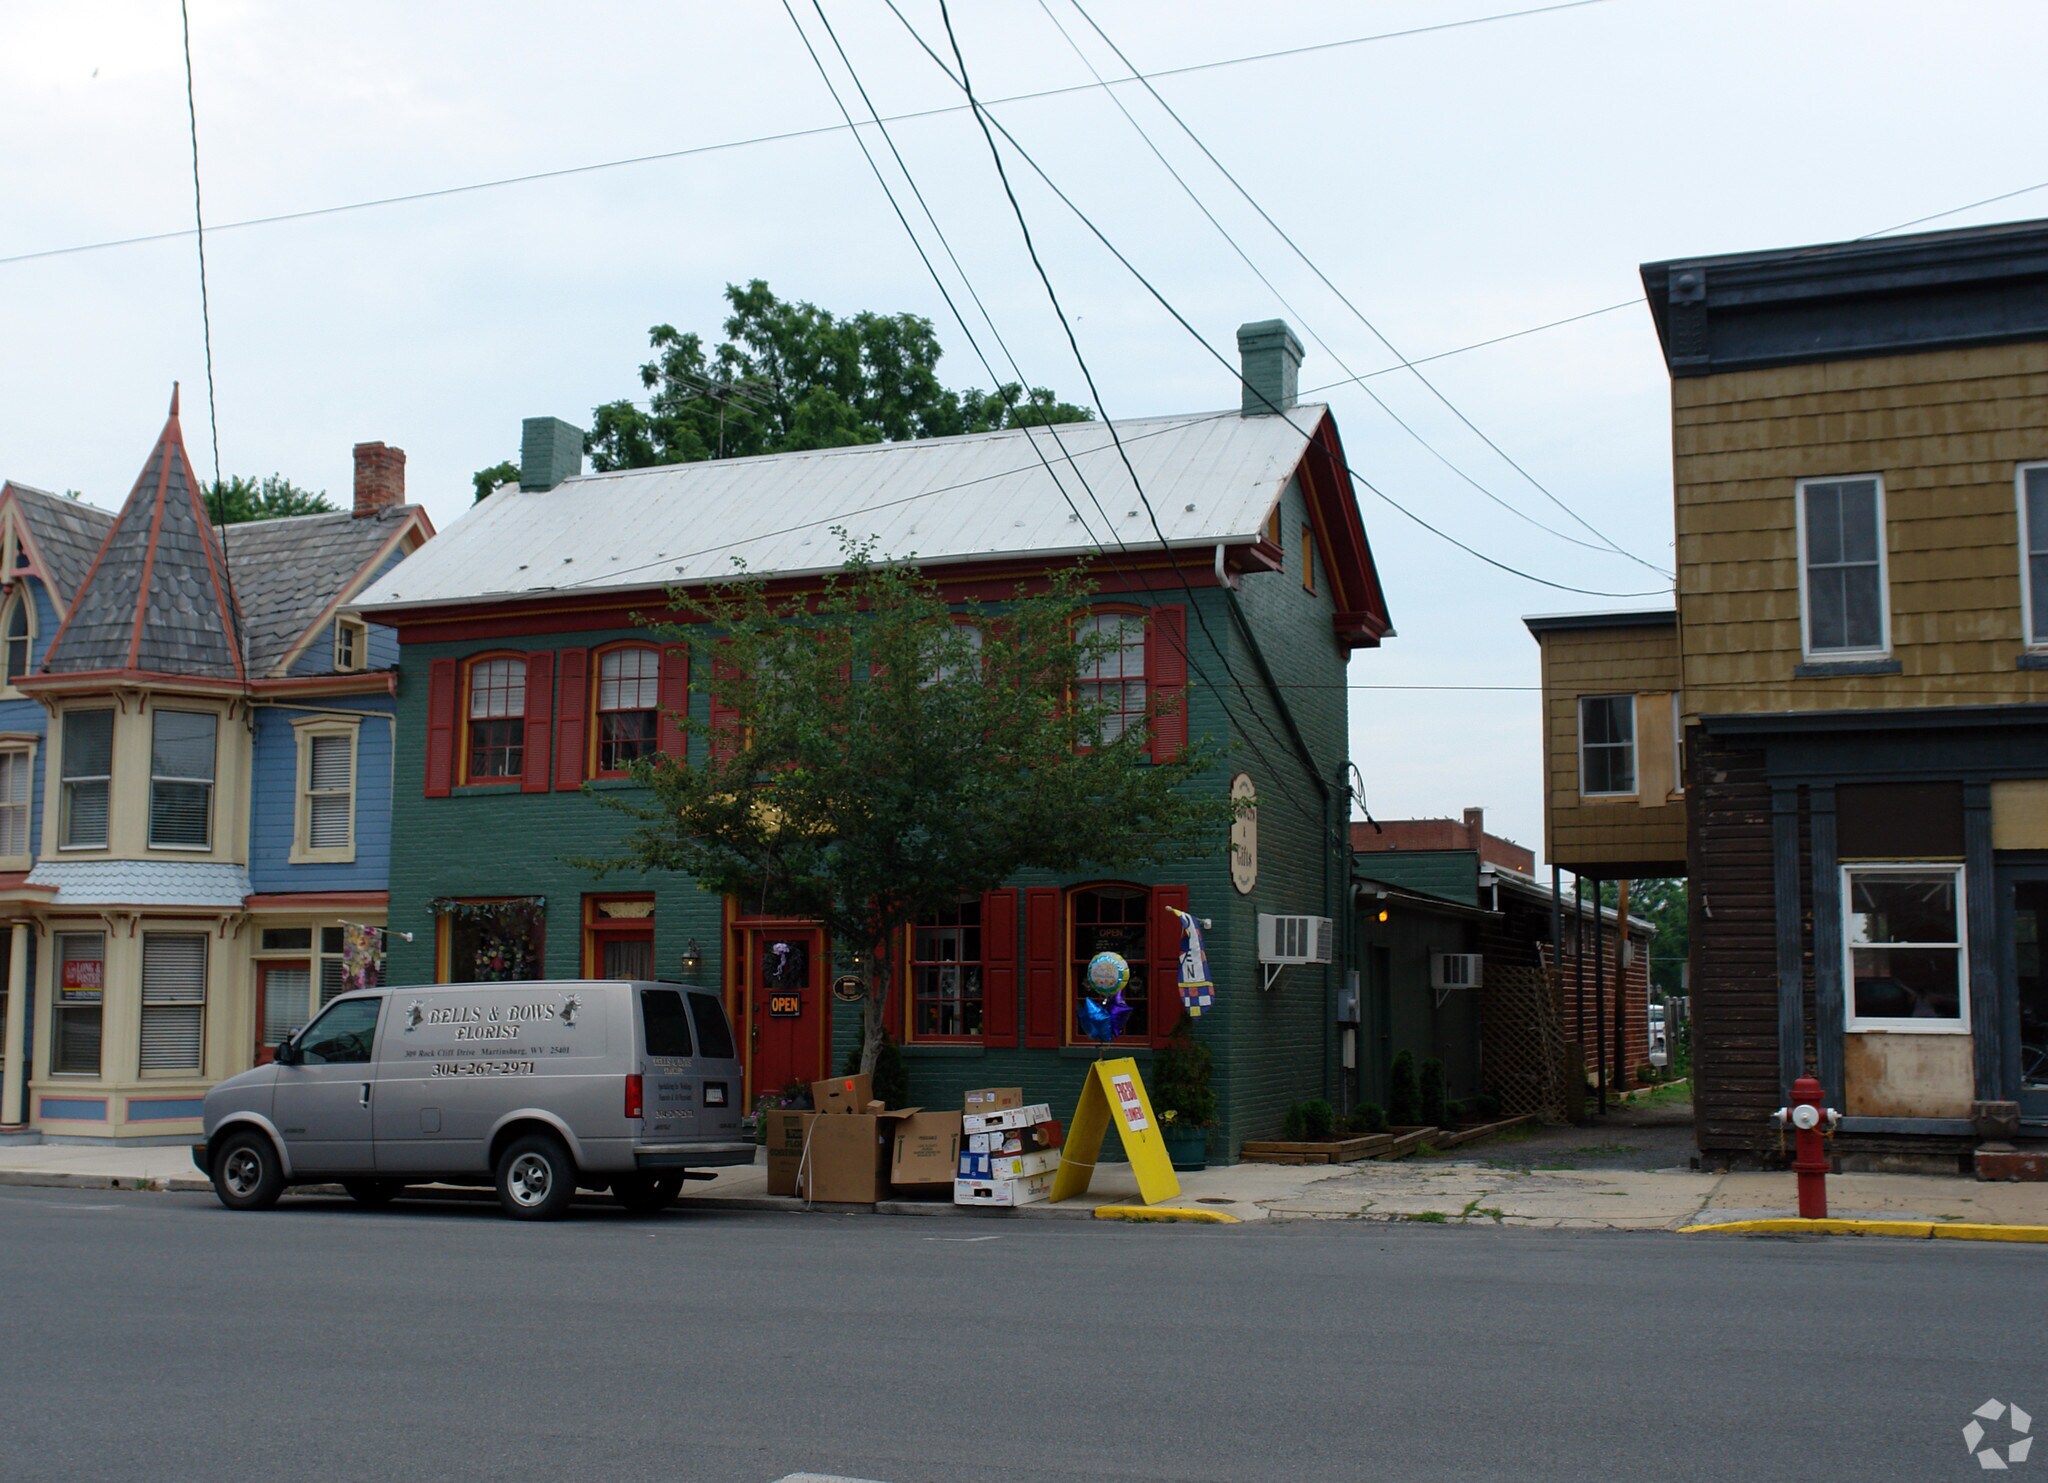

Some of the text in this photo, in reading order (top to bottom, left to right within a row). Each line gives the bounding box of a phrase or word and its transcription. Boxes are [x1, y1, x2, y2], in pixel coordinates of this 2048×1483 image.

[1099, 929, 1123, 937] OPEN
[77, 962, 94, 973] LONG
[771, 997, 798, 1012] OPEN
[427, 1003, 556, 1026] BELLS & BOWS
[454, 1024, 521, 1042] FLORIST
[418, 1049, 435, 1057] Rock
[437, 1048, 454, 1056] Cliff
[456, 1048, 475, 1056] Drive
[481, 1046, 527, 1055] Martinsburg,
[549, 1046, 570, 1054] 25401
[431, 1061, 535, 1077] 304-267-2971
[1114, 1081, 1138, 1103] FRESH
[1124, 1106, 1146, 1123] FLOWERS
